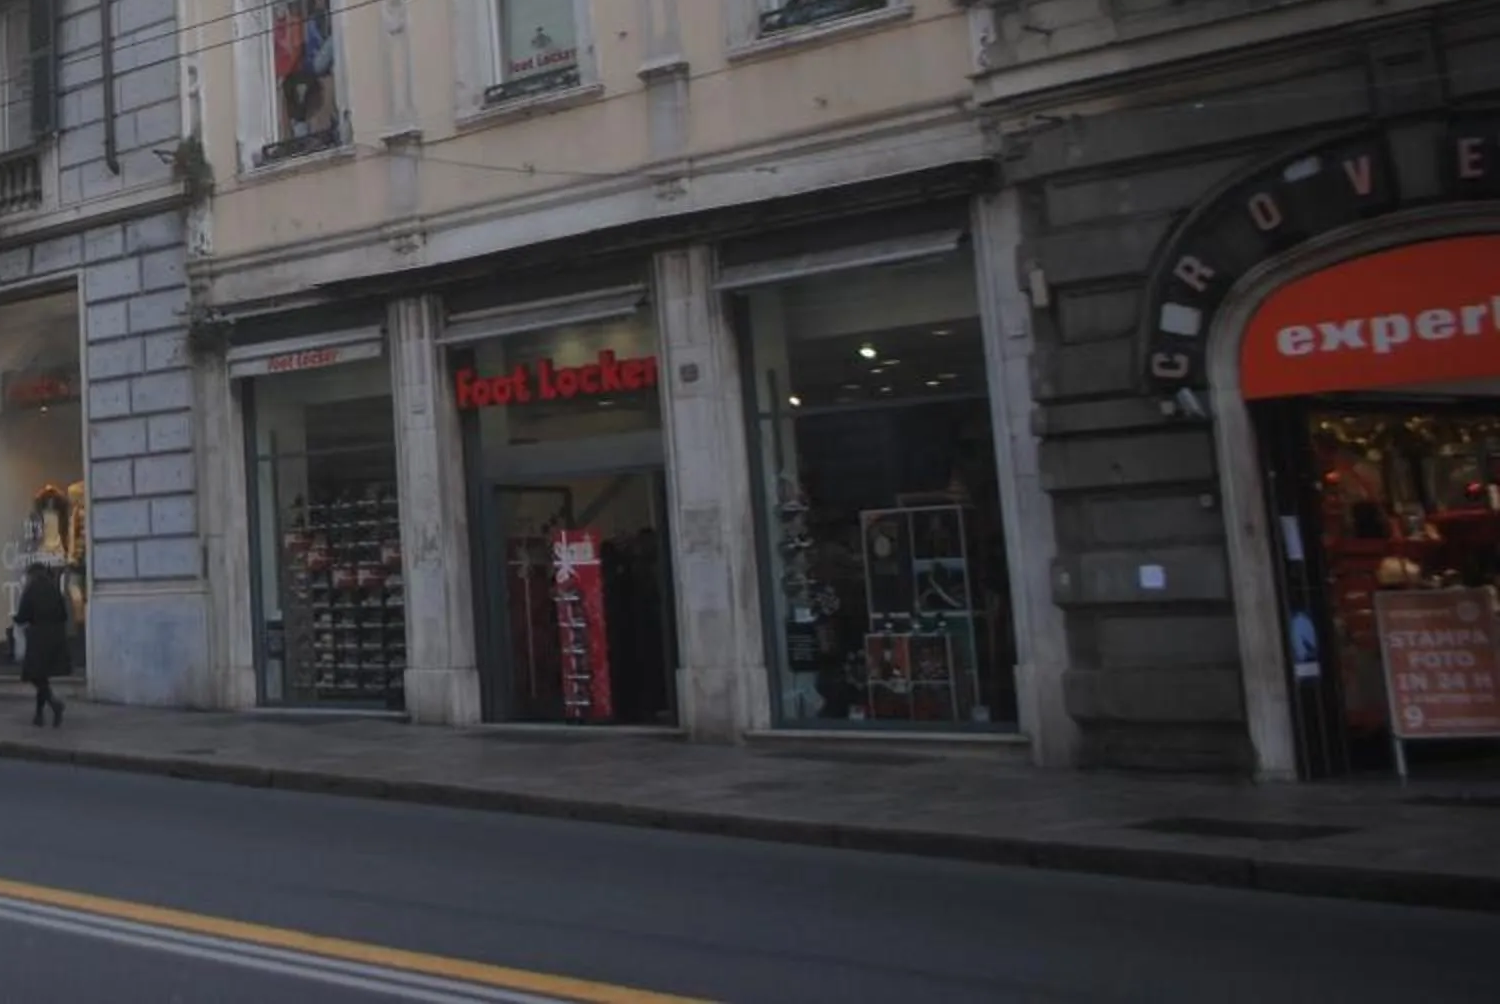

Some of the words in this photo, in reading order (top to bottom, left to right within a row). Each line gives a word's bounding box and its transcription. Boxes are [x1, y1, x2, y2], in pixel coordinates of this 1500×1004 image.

[1152, 134, 1500, 379] CROVE
[456, 363, 532, 411] Foot
[536, 348, 658, 400] Locker
[1388, 628, 1490, 649] STAMPA
[1407, 650, 1476, 669] FOTO
